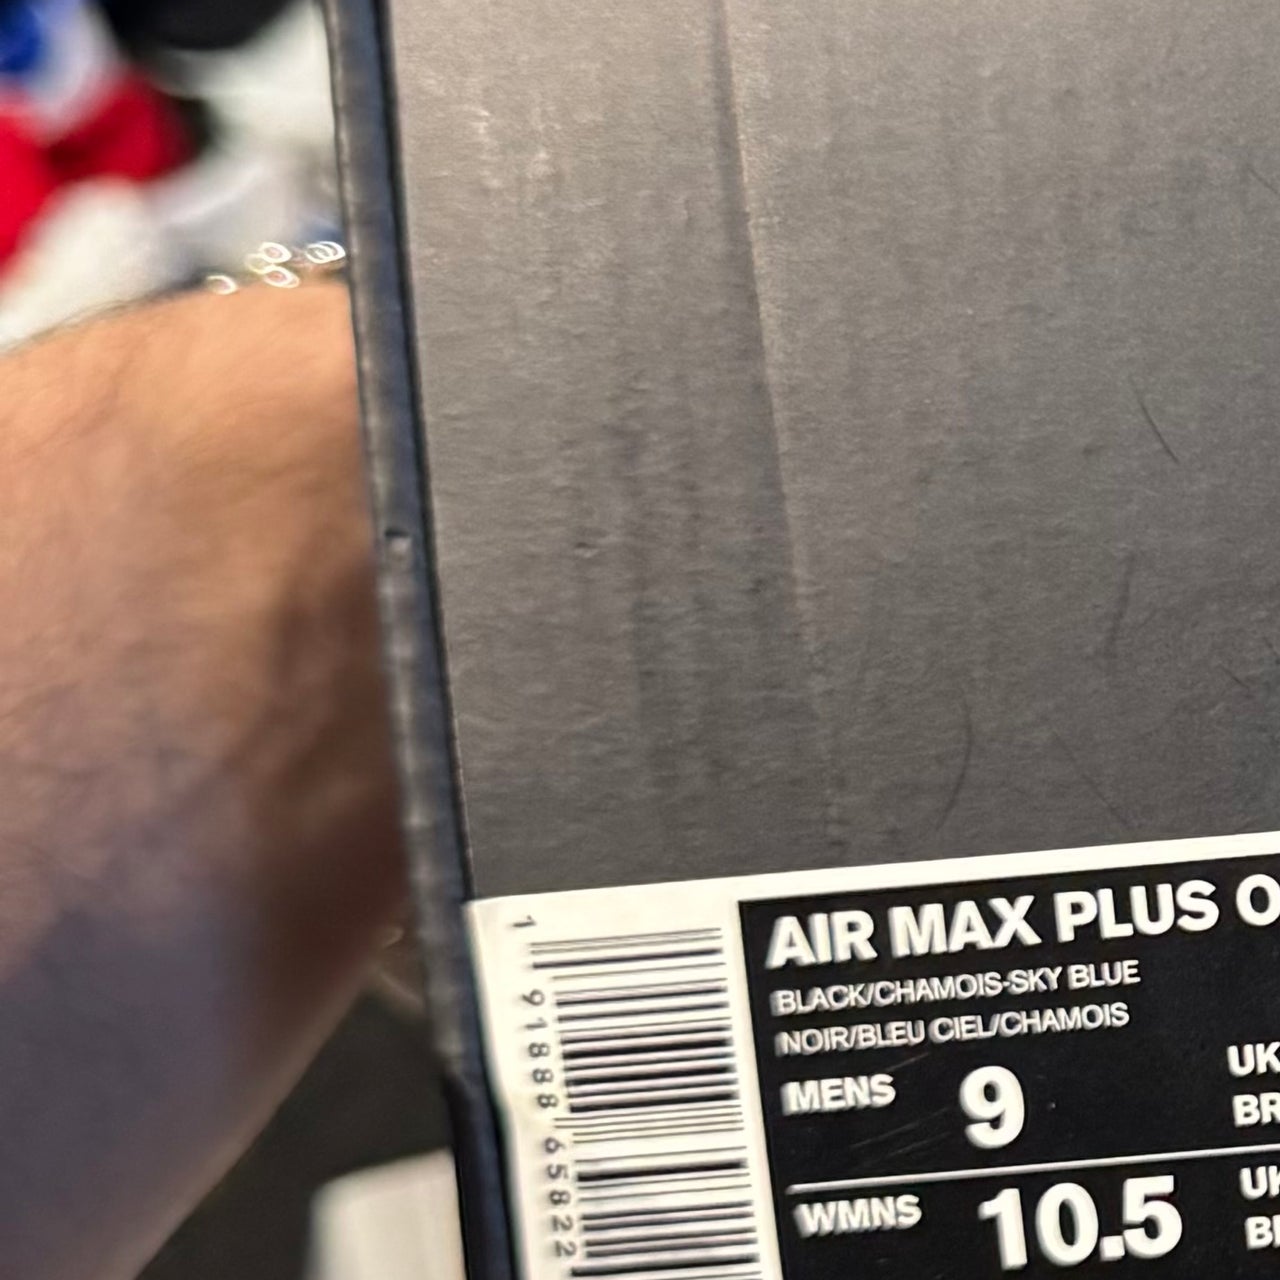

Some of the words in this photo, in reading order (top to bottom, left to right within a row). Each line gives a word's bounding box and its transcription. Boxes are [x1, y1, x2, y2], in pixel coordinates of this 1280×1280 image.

[764, 909, 878, 970] AIR
[890, 894, 1041, 958] MAX
[1052, 880, 1219, 942] PLUS
[770, 965, 1062, 1016] BLACK/CHAMOIS-SKY
[1068, 959, 1141, 990] BLUE
[775, 1019, 926, 1057] NOIR/BLEU
[930, 1002, 1129, 1043] CIEL/CHAMOIS
[521, 989, 560, 1109] 91888
[543, 1136, 577, 1258] 65822
[780, 1073, 896, 1116] MENS
[958, 1065, 1025, 1149] 9
[793, 1194, 922, 1238] WMNS
[978, 1175, 1183, 1271] 10.5
